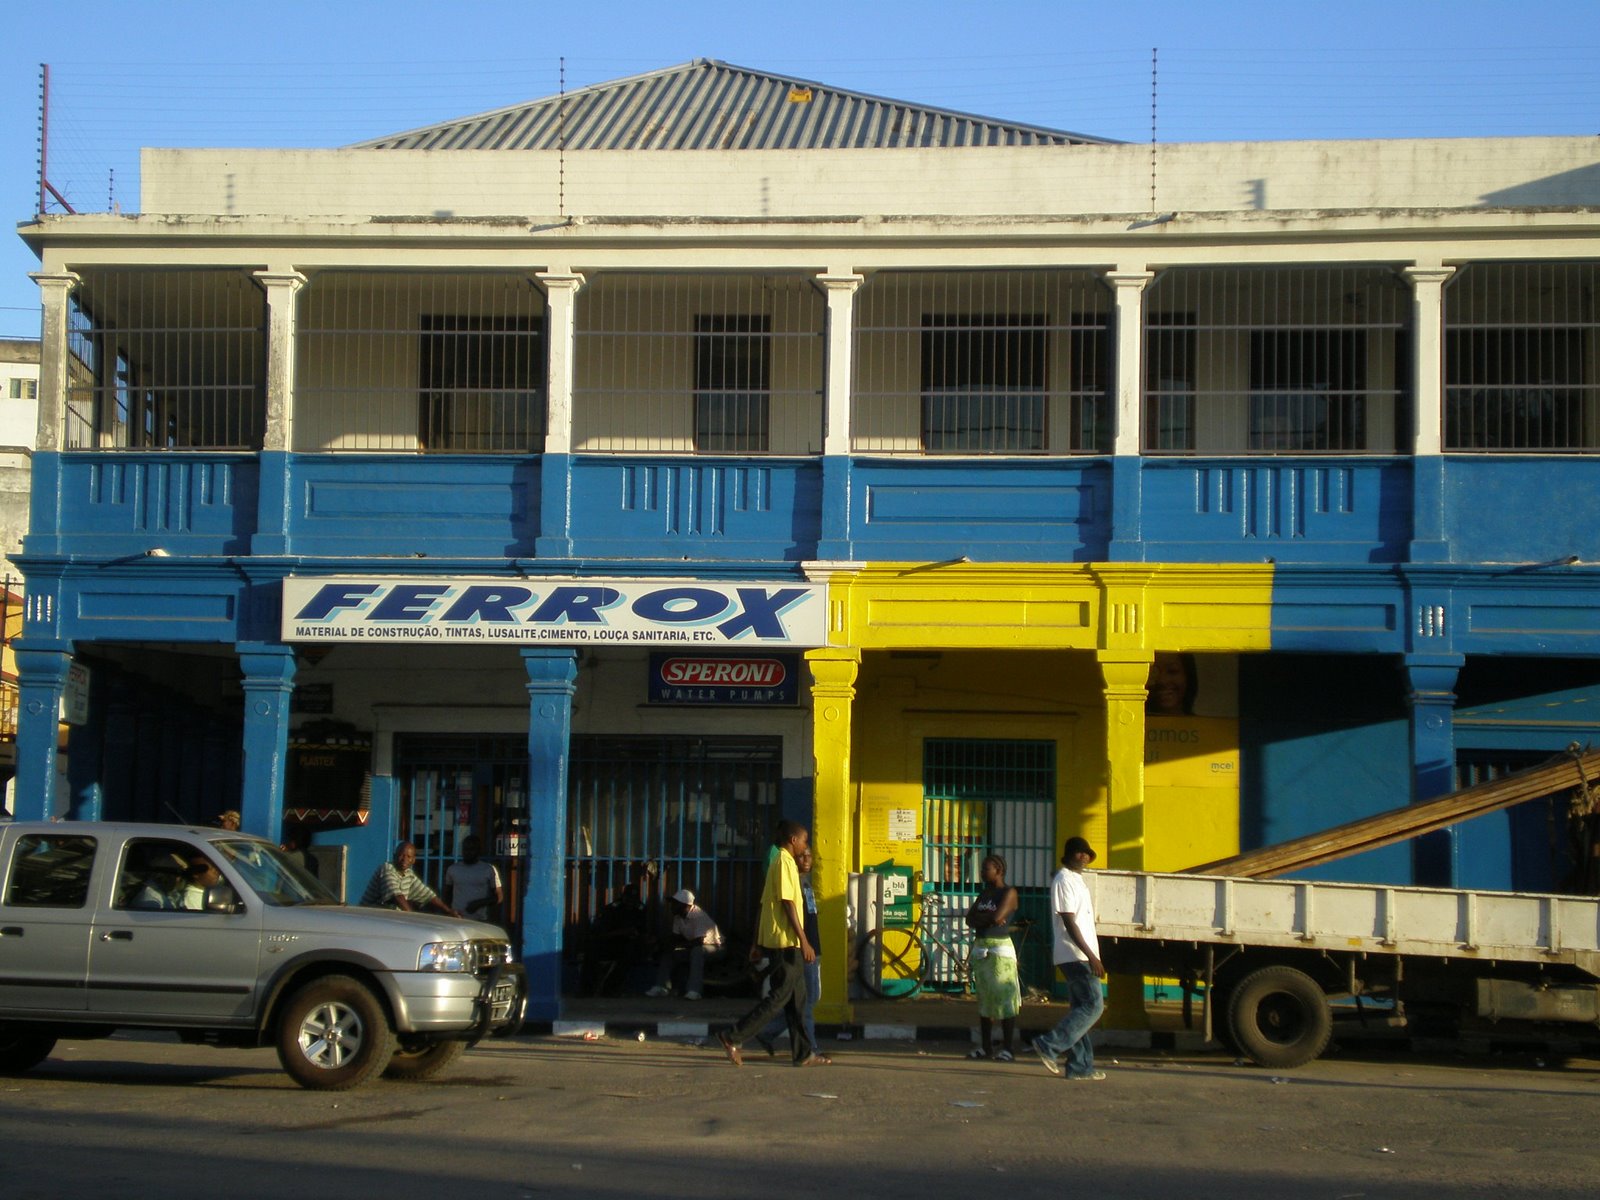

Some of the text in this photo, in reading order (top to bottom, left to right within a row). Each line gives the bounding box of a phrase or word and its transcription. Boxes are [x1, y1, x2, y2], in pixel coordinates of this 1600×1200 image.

[293, 584, 813, 640] FERROX
[295, 626, 348, 637] MATERIAL
[350, 627, 364, 637] DE
[367, 624, 443, 638] CONSTRUÇÃO,
[445, 627, 485, 639] TINTAS,
[593, 630, 629, 641] LOUÇA
[632, 630, 690, 641] SANITARIA,
[693, 631, 716, 641] ETC.
[667, 662, 776, 682] SPERONI
[661, 688, 785, 700] WATER PUMPS
[1148, 729, 1199, 743] amos
